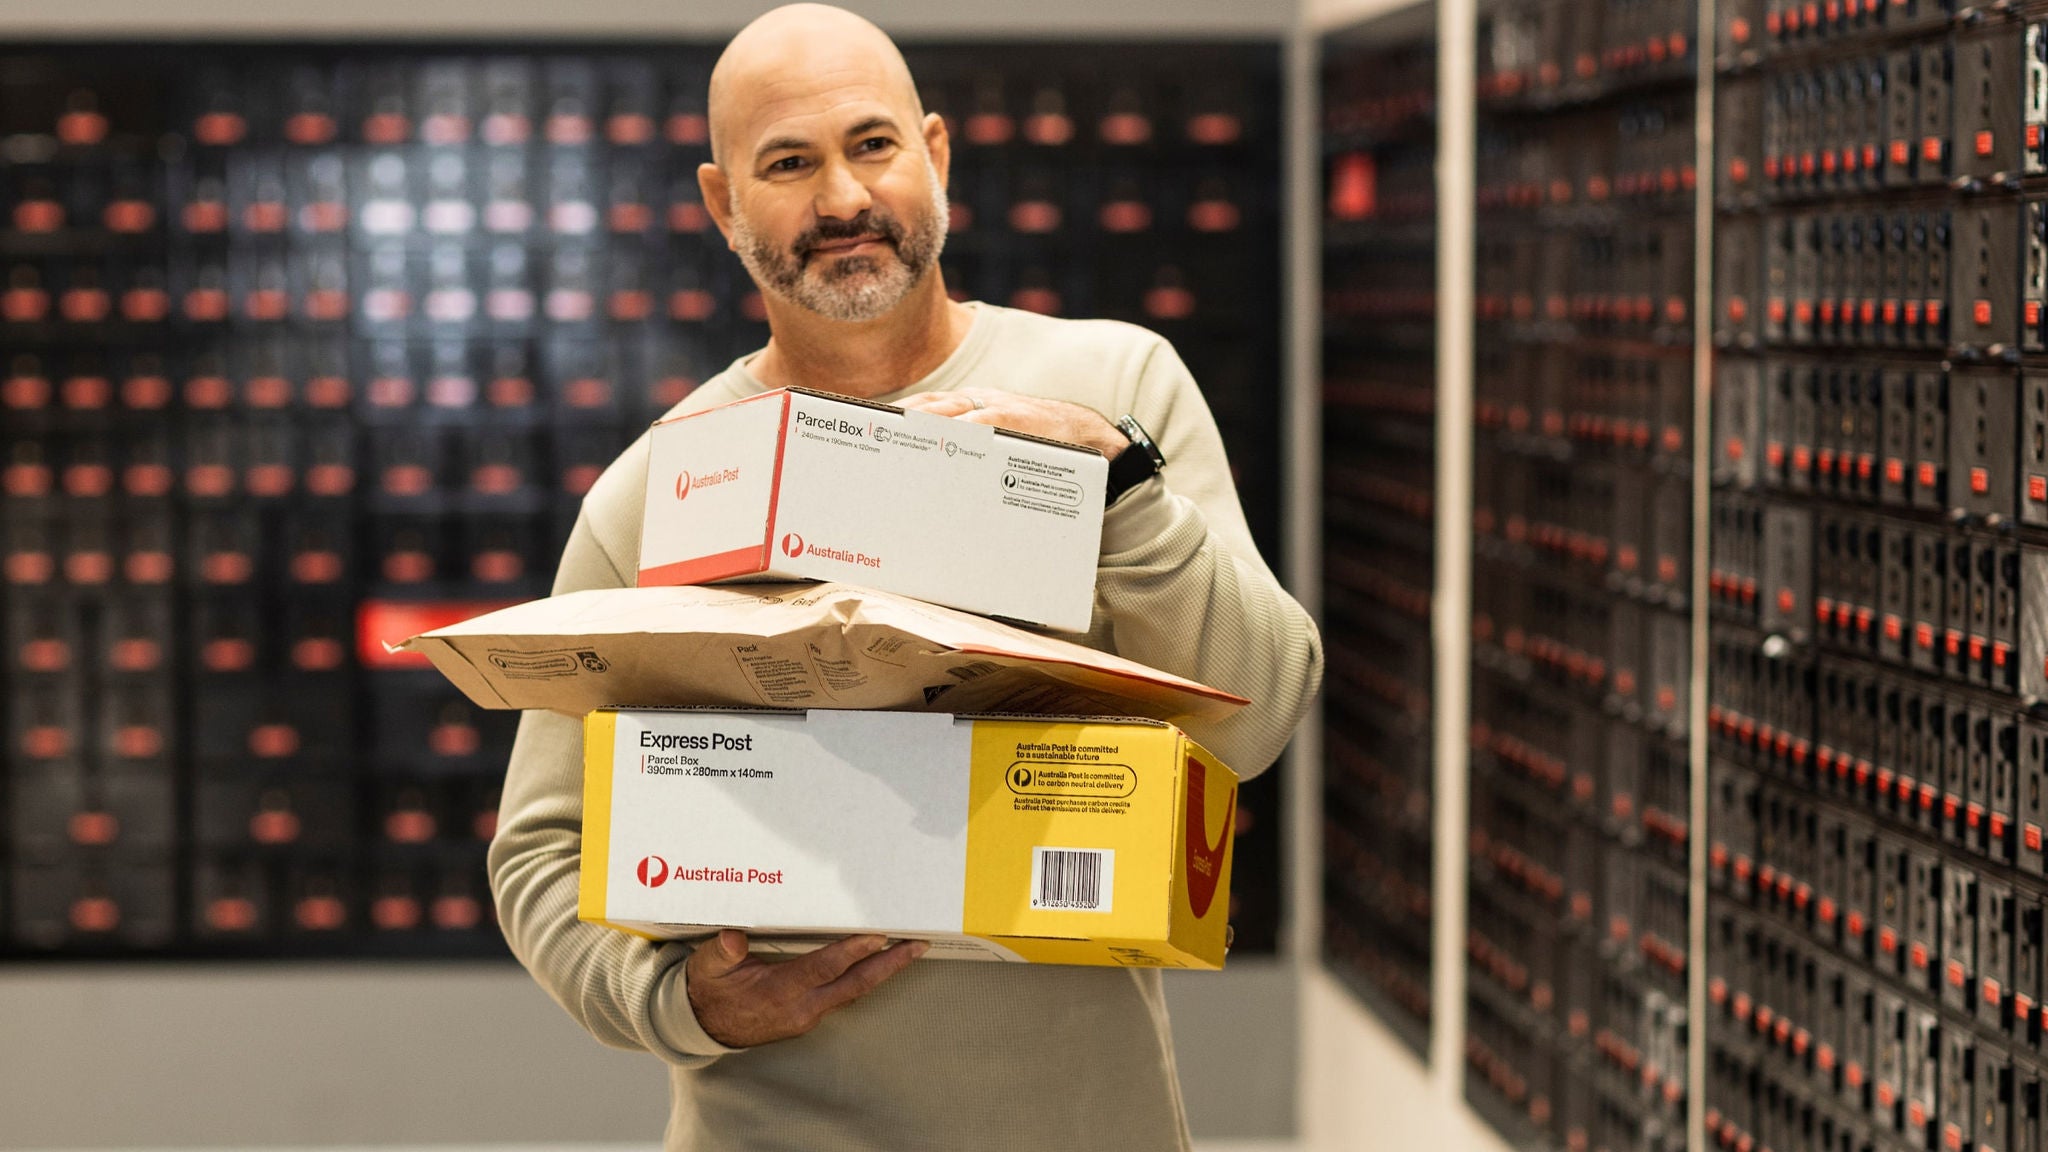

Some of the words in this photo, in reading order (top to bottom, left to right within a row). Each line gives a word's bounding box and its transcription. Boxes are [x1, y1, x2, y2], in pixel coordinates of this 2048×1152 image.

[796, 411, 837, 431] Parcel
[839, 420, 864, 437] Box
[801, 431, 825, 441] 240mm
[831, 437, 853, 447] 190mm
[859, 443, 881, 453] 120mm
[893, 431, 912, 440] Within
[913, 435, 938, 446] Australia
[1008, 456, 1030, 465] Australia
[1048, 464, 1075, 474] committed
[691, 471, 722, 490] Australia
[723, 467, 739, 483] Post
[806, 543, 854, 563] Australia
[856, 553, 881, 568] Post
[737, 643, 759, 653] Pack
[640, 731, 709, 751] Express
[712, 733, 753, 751] Post
[1016, 743, 1051, 751] Australia
[1051, 744, 1069, 752] Post
[1070, 744, 1077, 752] is
[1077, 746, 1119, 754] committed
[648, 754, 678, 765] Parcel
[680, 755, 699, 765] Box
[1032, 752, 1075, 760] sustainable
[1076, 753, 1100, 761] future
[647, 765, 683, 776] 390mm
[685, 768, 691, 776] x
[692, 766, 728, 777] 280mm
[730, 769, 736, 778] x
[738, 767, 774, 779] 140mm
[1071, 780, 1095, 788] neutral
[1096, 781, 1124, 790] delivery
[673, 866, 743, 882] Australia
[747, 868, 783, 884] Post
[1042, 899, 1068, 908] 312650
